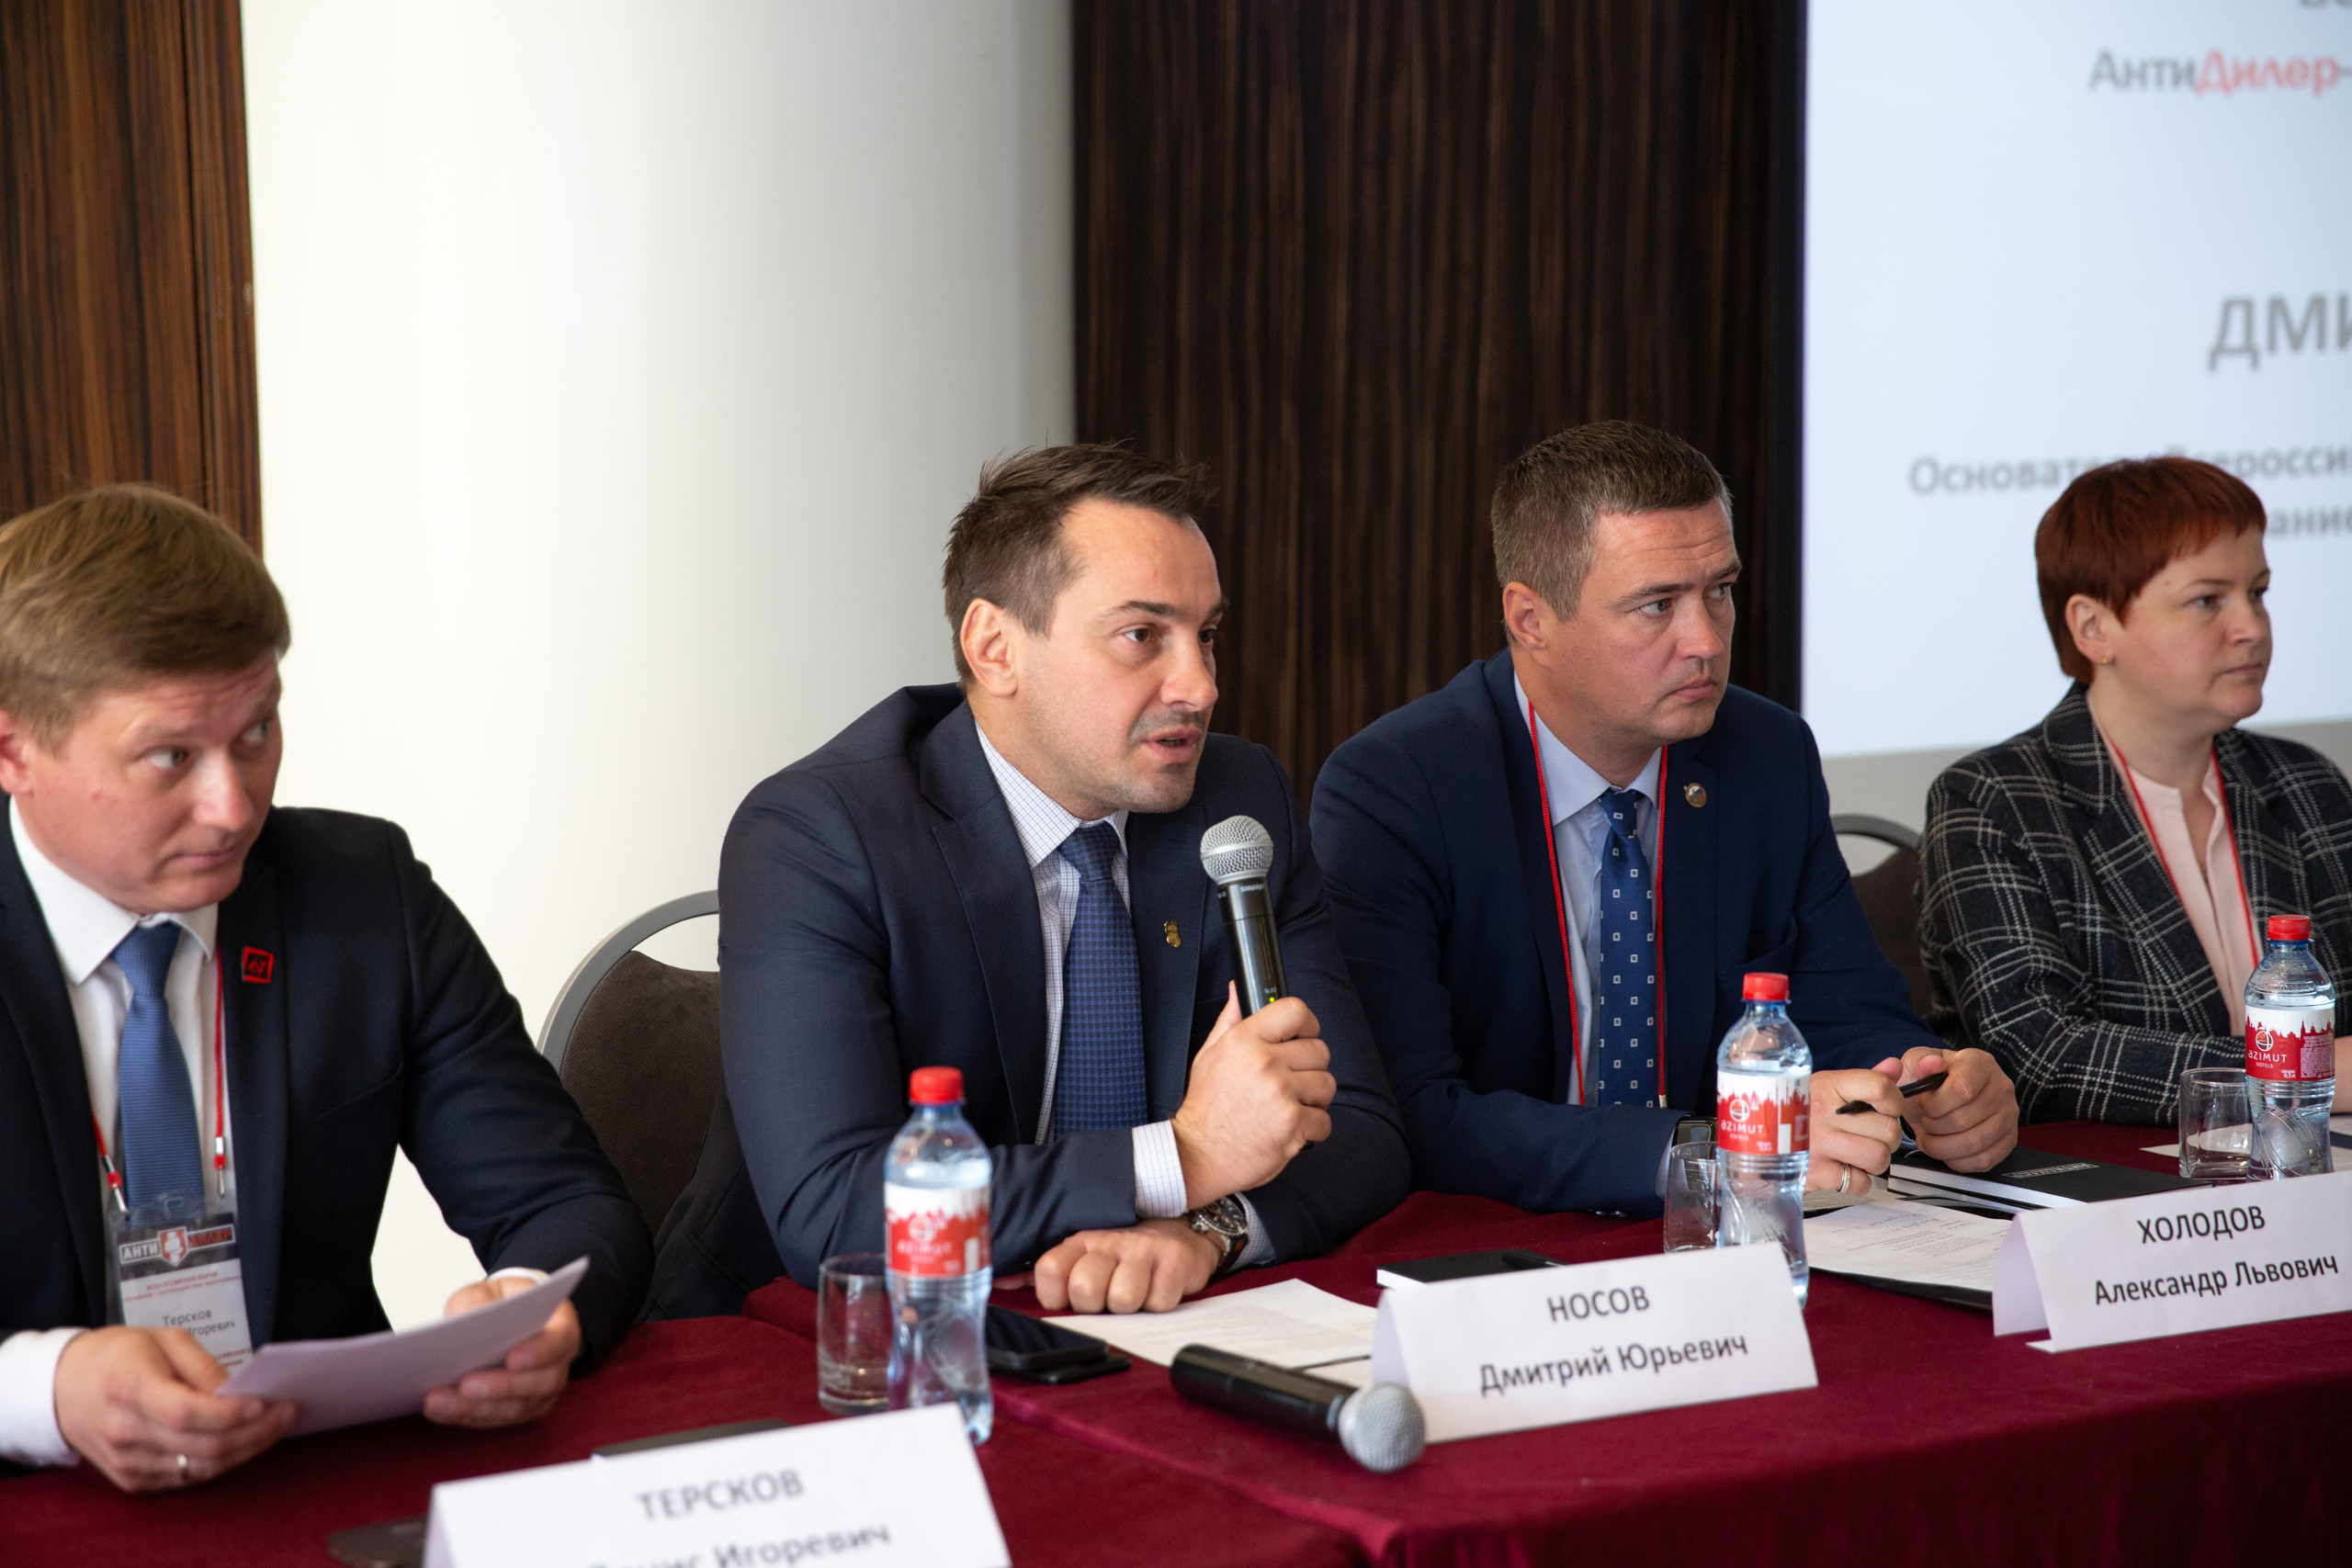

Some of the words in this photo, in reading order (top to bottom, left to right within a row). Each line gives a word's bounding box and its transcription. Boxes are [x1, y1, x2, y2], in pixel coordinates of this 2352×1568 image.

[2136, 1205, 2266, 1244] ХОЛОДОВ
[124, 1242, 158, 1260] АНТИ
[2095, 1269, 2228, 1305] Александр
[2234, 1255, 2339, 1287] Львович
[163, 1310, 212, 1326] Терсков
[1547, 1285, 1650, 1322] НОСОВ
[1479, 1348, 1611, 1397] Дмитрий
[1617, 1334, 1749, 1378] Юрьевич
[635, 1469, 806, 1522] ТЕРСКОВ
[713, 1522, 891, 1568] Игоревич
